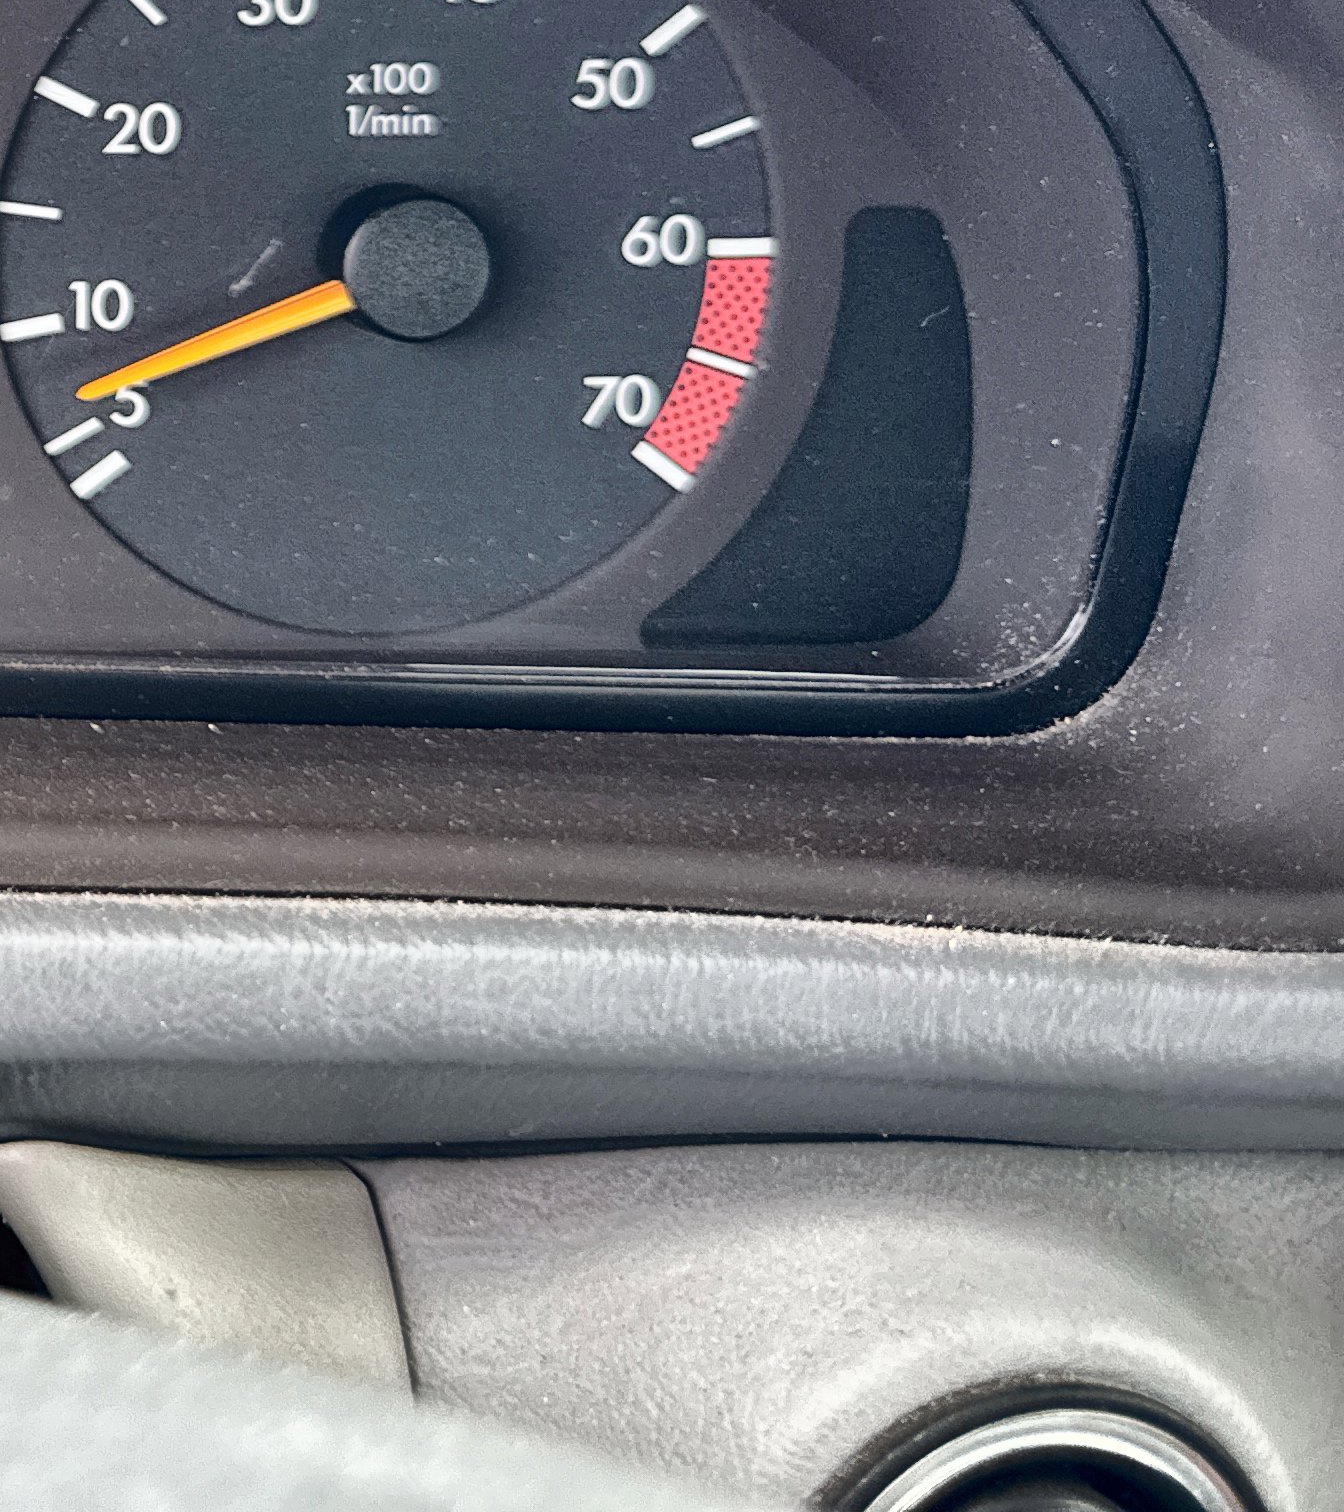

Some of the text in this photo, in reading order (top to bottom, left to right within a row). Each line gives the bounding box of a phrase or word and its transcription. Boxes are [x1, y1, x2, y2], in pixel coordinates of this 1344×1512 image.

[345, 62, 435, 95] x100
[571, 57, 651, 110] 50
[101, 102, 180, 155] 20
[345, 104, 435, 136] 1/min
[621, 214, 703, 267] 60
[68, 279, 134, 332] 10
[109, 379, 150, 428] 5
[581, 374, 659, 426] 70
